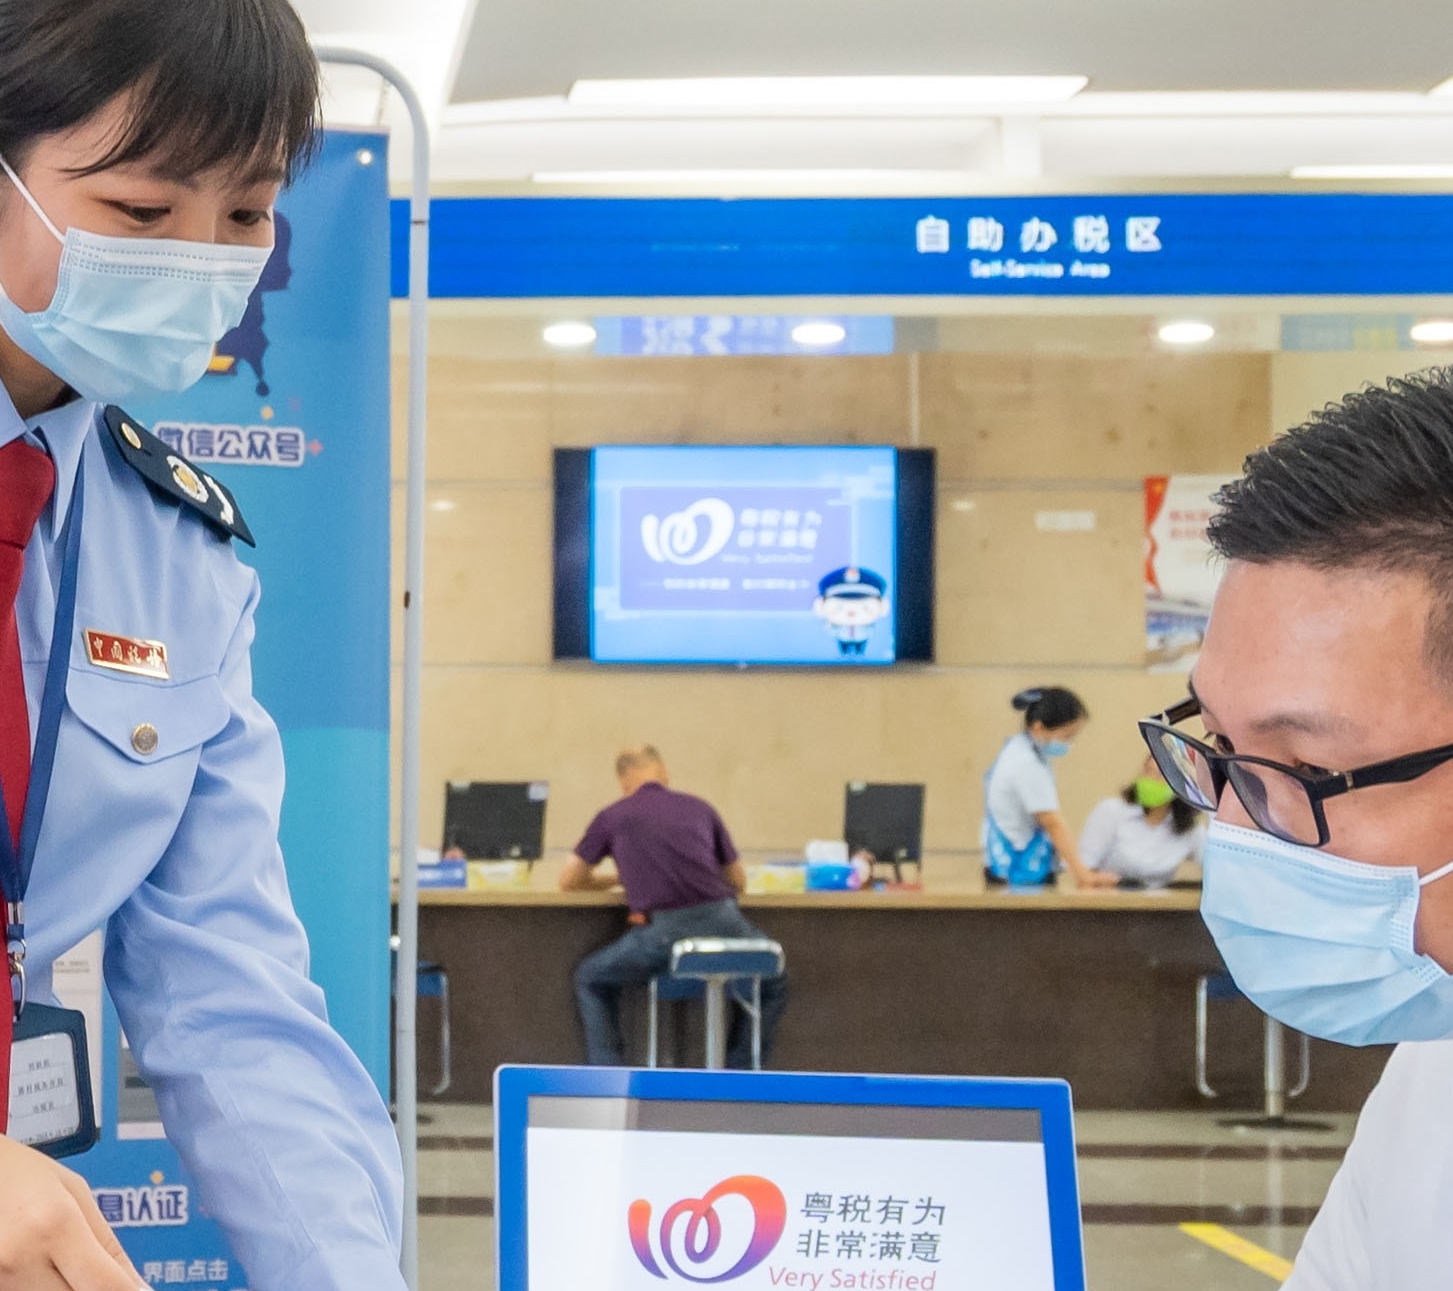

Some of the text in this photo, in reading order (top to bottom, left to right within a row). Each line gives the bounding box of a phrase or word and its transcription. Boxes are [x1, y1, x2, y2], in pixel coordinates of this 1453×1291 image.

[916, 214, 1162, 253] 自助办税区
[800, 1189, 947, 1228] 粤税有为
[796, 1228, 943, 1265] 非常满意
[144, 1260, 228, 1282] 界面点击
